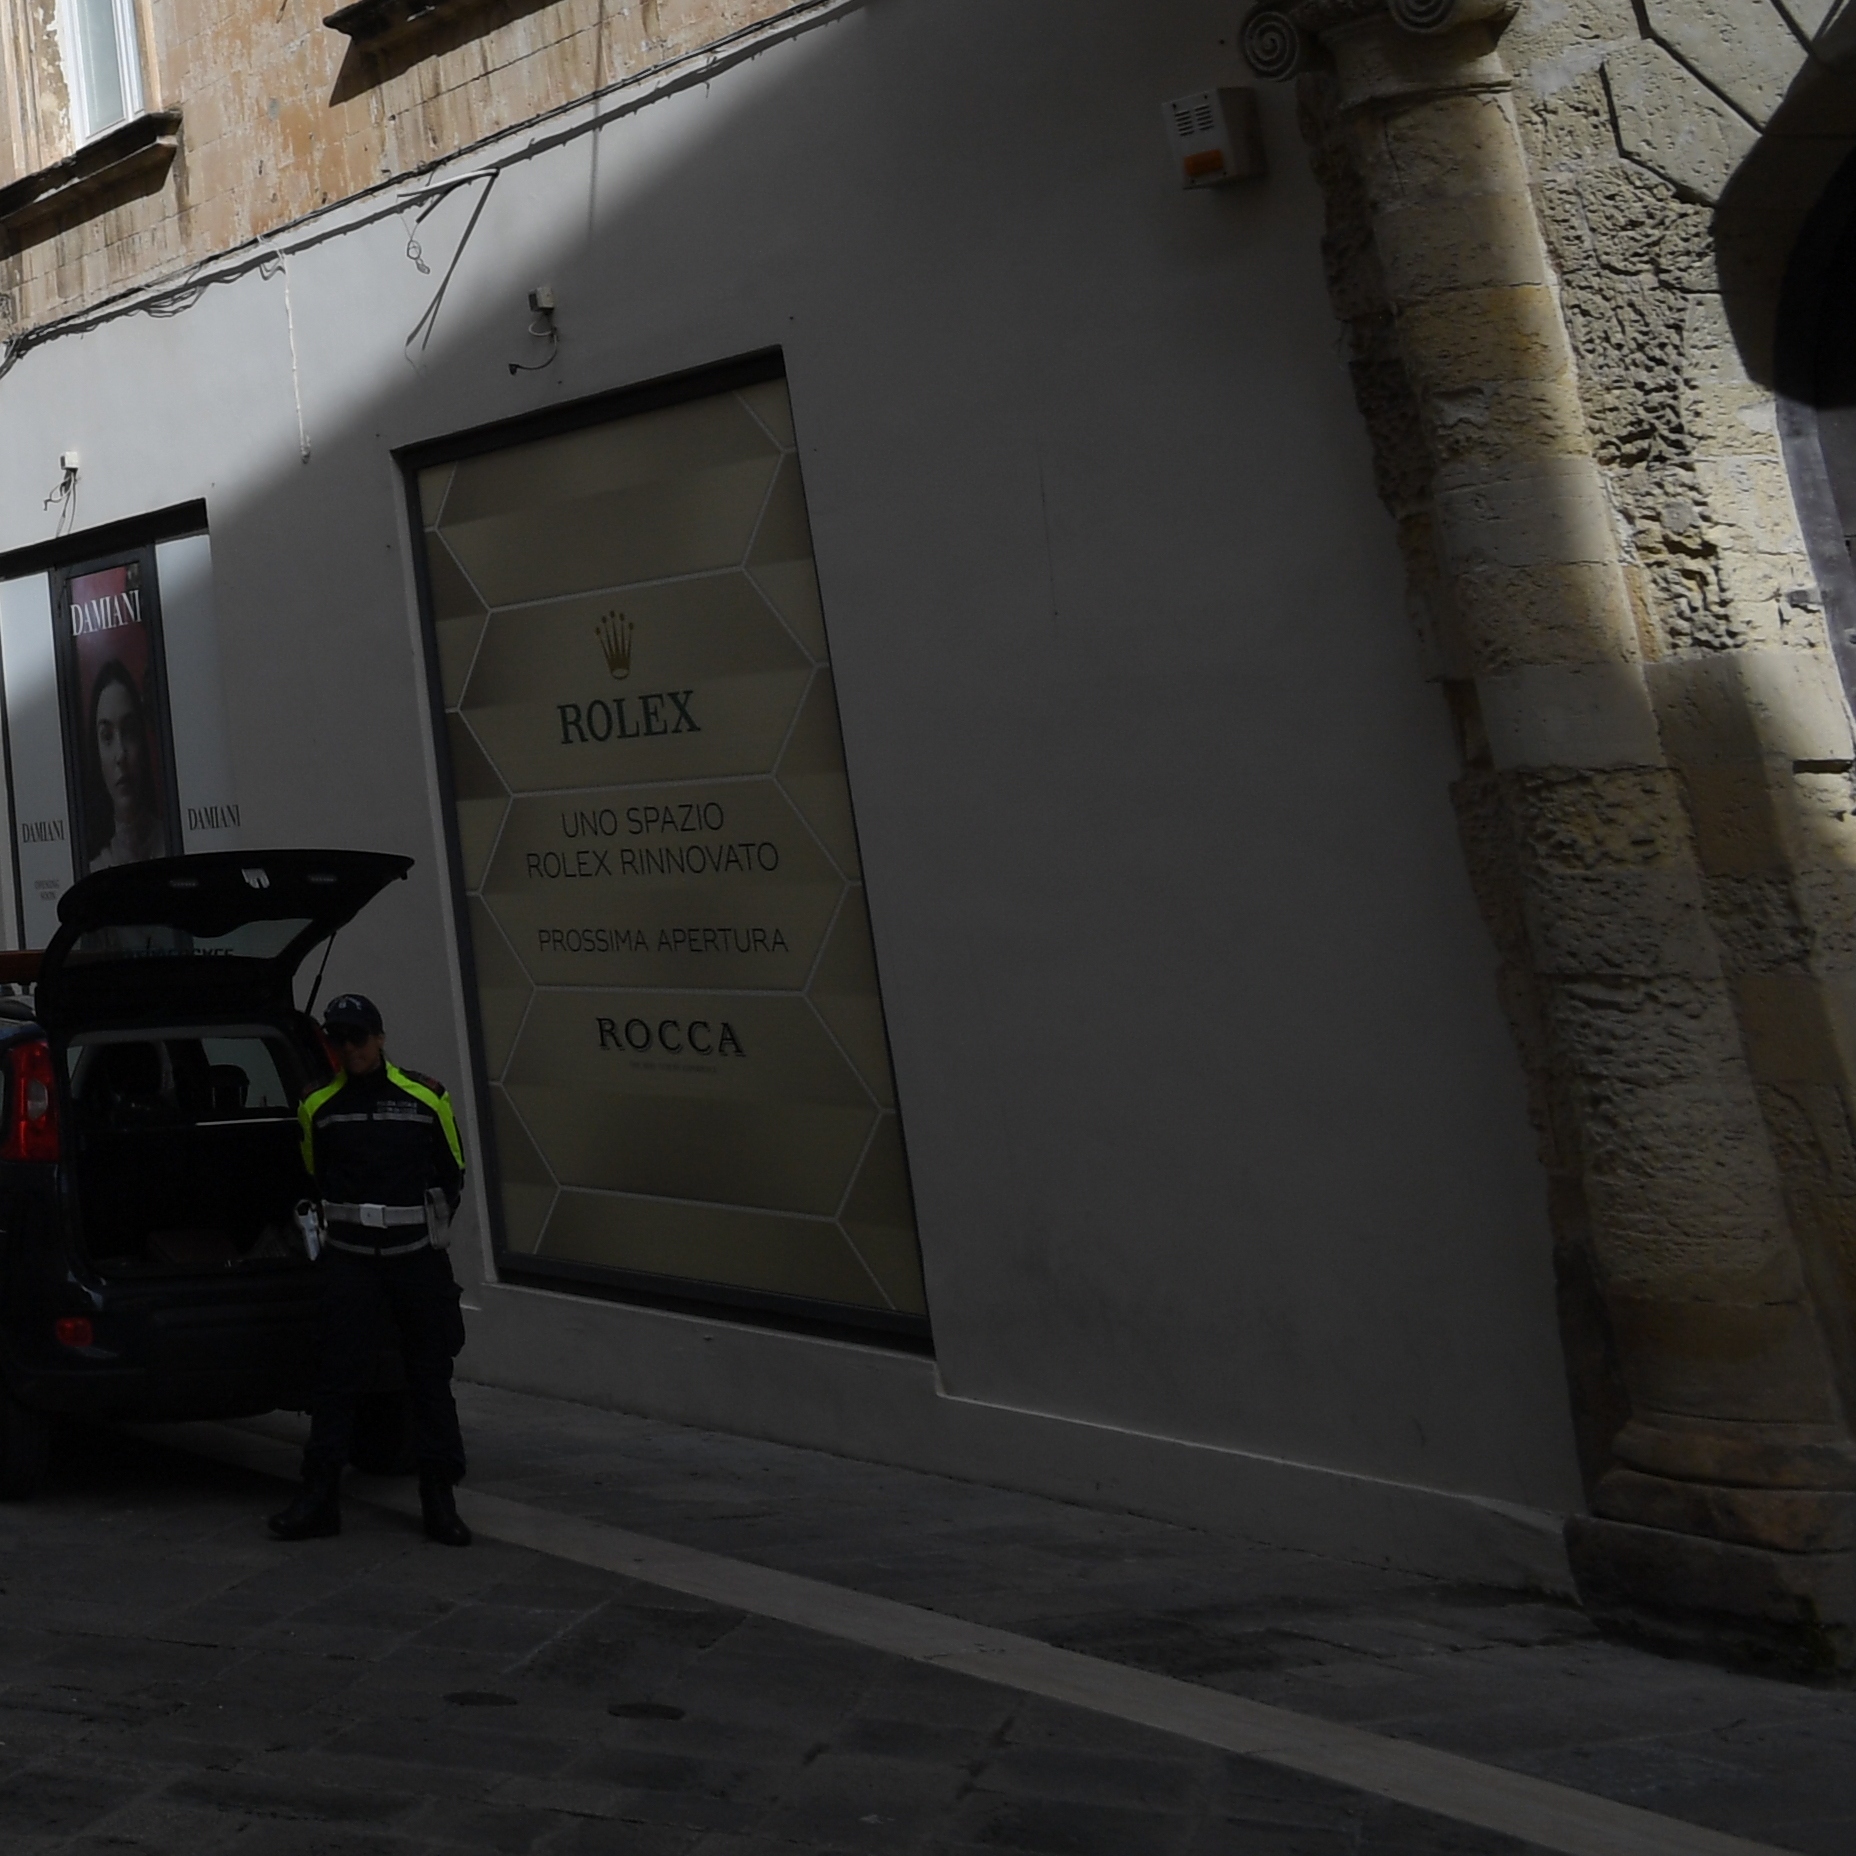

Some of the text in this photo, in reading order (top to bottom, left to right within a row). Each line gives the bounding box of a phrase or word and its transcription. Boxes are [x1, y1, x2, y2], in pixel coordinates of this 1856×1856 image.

[70, 589, 142, 636] DAMIANI
[557, 690, 701, 744] ROLEX
[22, 819, 65, 843] DAMIANI
[188, 804, 240, 831] DAMIANI
[561, 802, 724, 838] UNO SPAZIO
[527, 842, 780, 879] ROLEX RINNOVATO
[538, 928, 789, 953] PROSSIMA APERTURA
[595, 1017, 747, 1057] ROCCA
